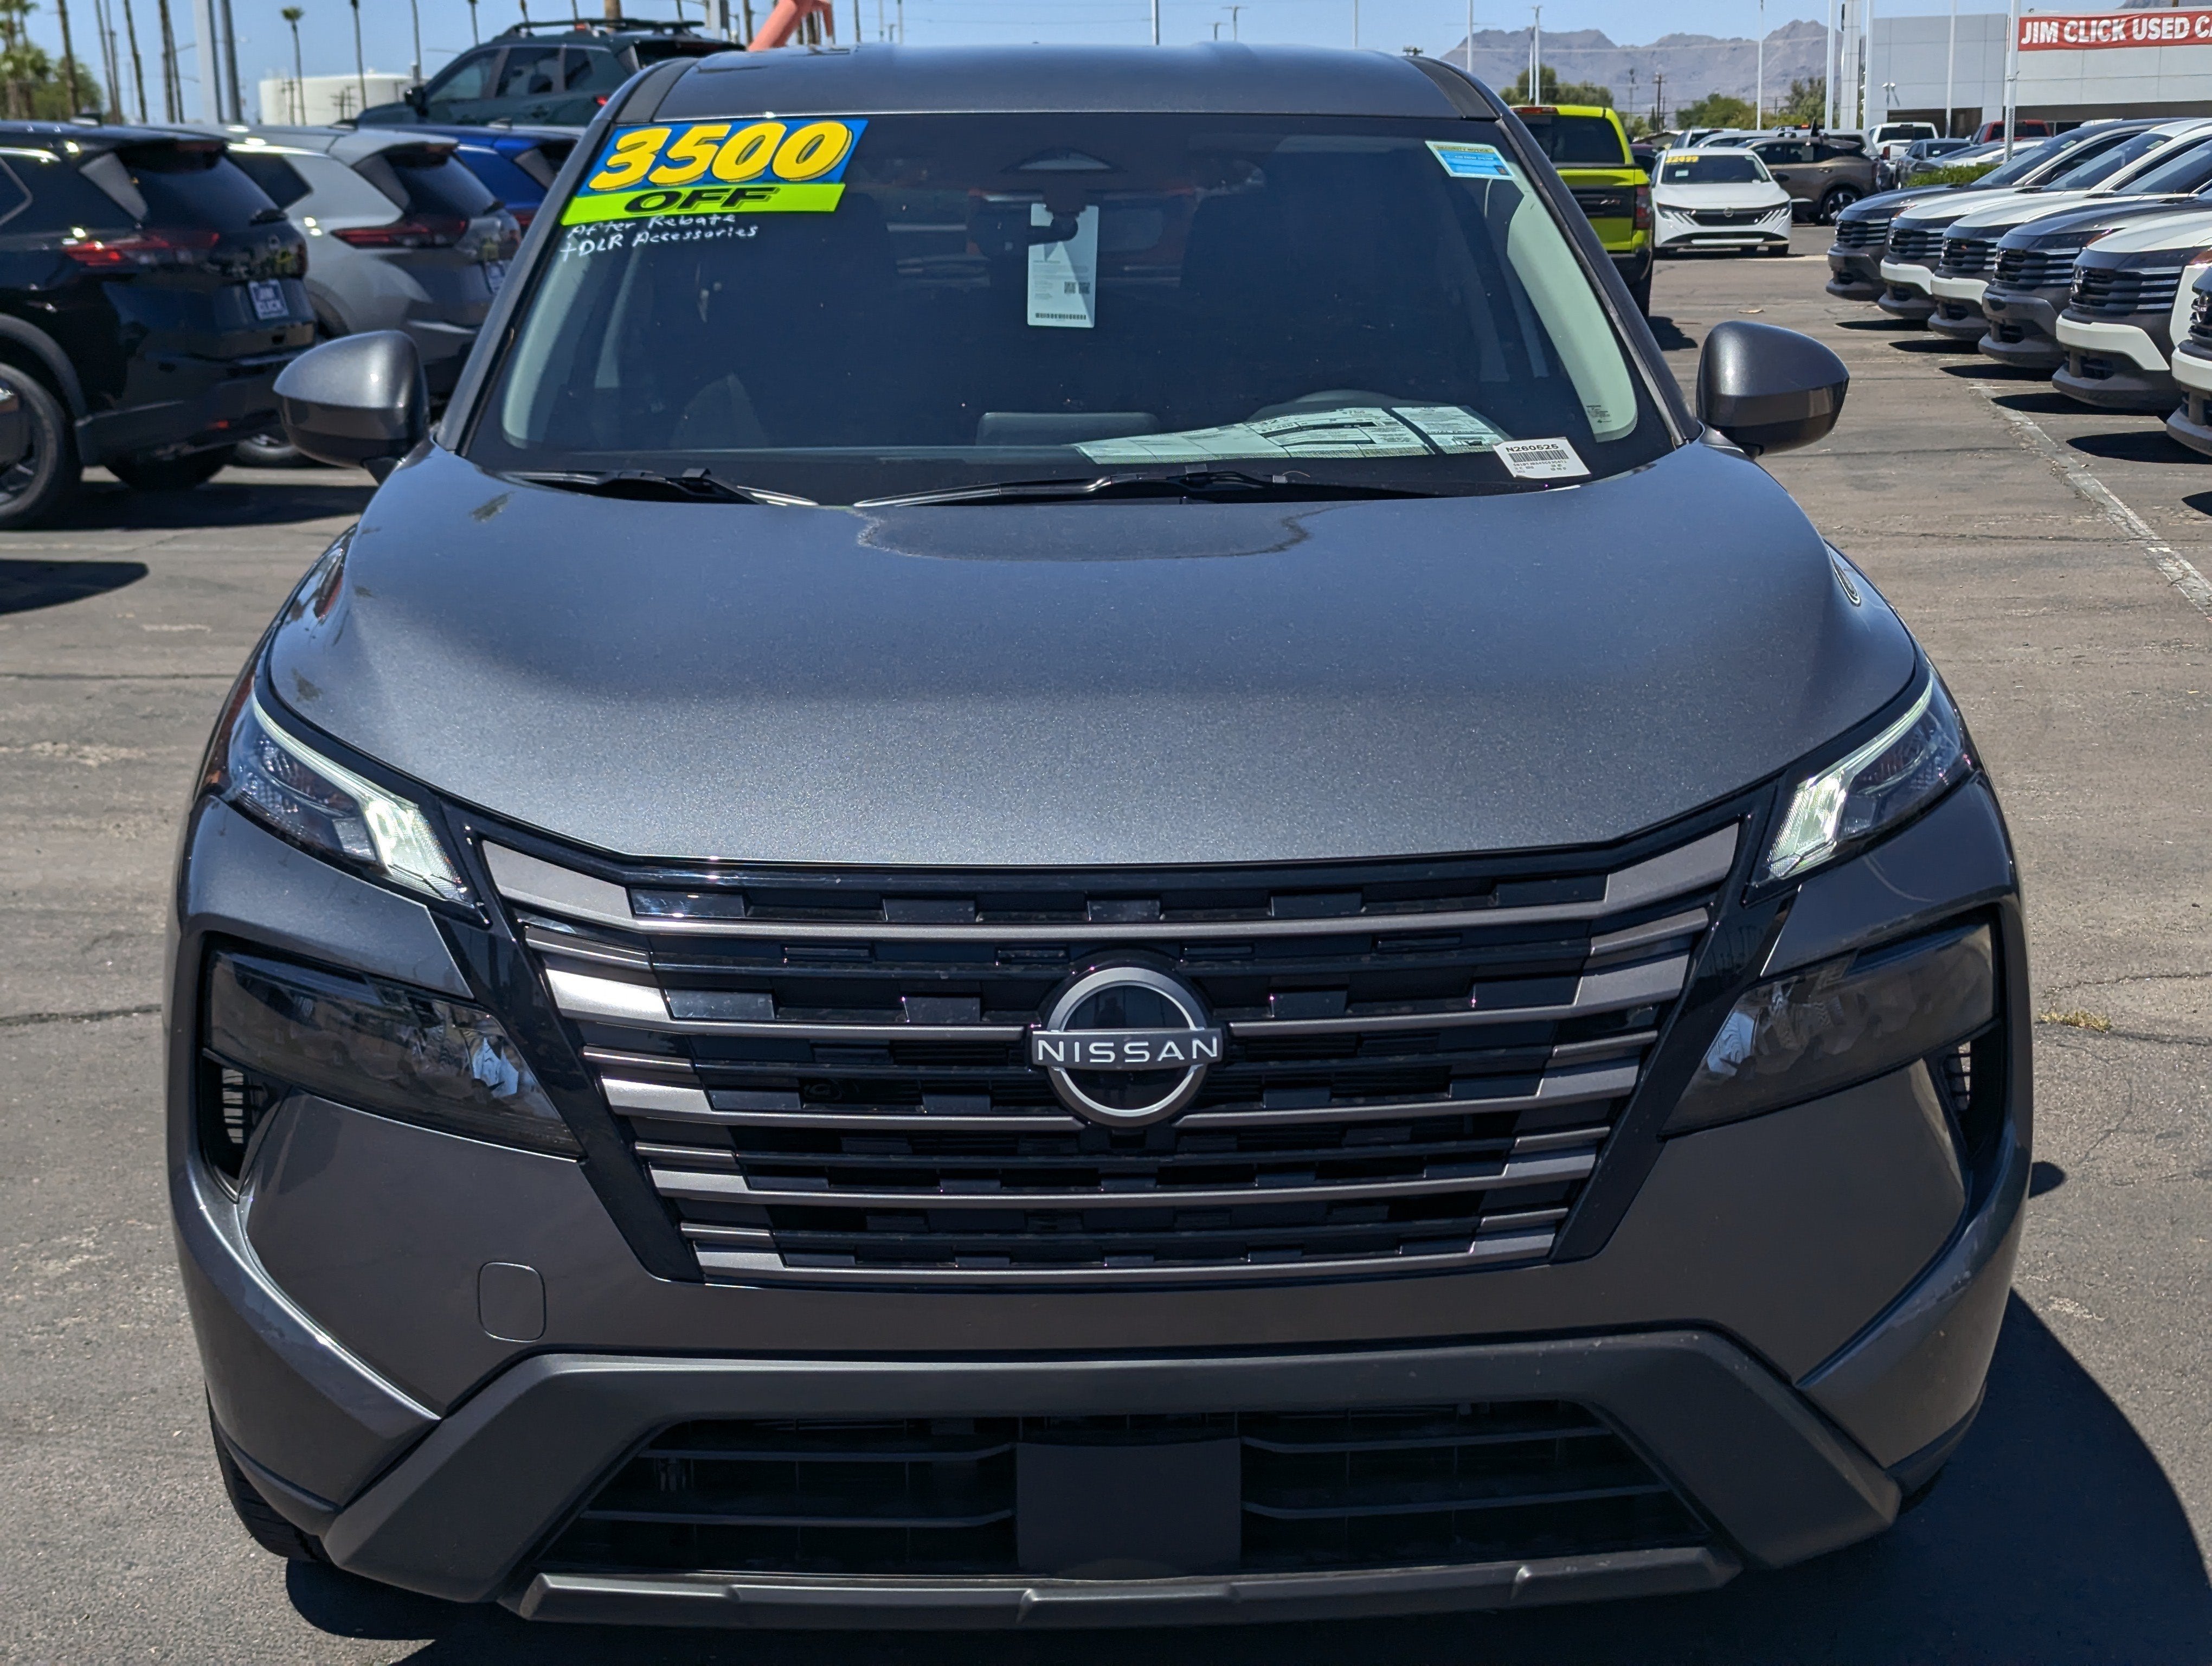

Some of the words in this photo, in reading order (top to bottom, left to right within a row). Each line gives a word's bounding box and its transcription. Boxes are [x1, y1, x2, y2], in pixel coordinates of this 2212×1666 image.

[2021, 21, 2059, 44] JIM
[2063, 19, 2127, 43] CLICK
[2132, 17, 2190, 40] USED
[2194, 15, 2212, 38] C
[589, 121, 853, 191] 3500
[624, 187, 781, 214] OFF
[648, 214, 736, 229] Rebate
[560, 234, 623, 261] +DLR
[632, 225, 758, 247] Accessories
[1038, 1036, 1218, 1063] NISSAN
